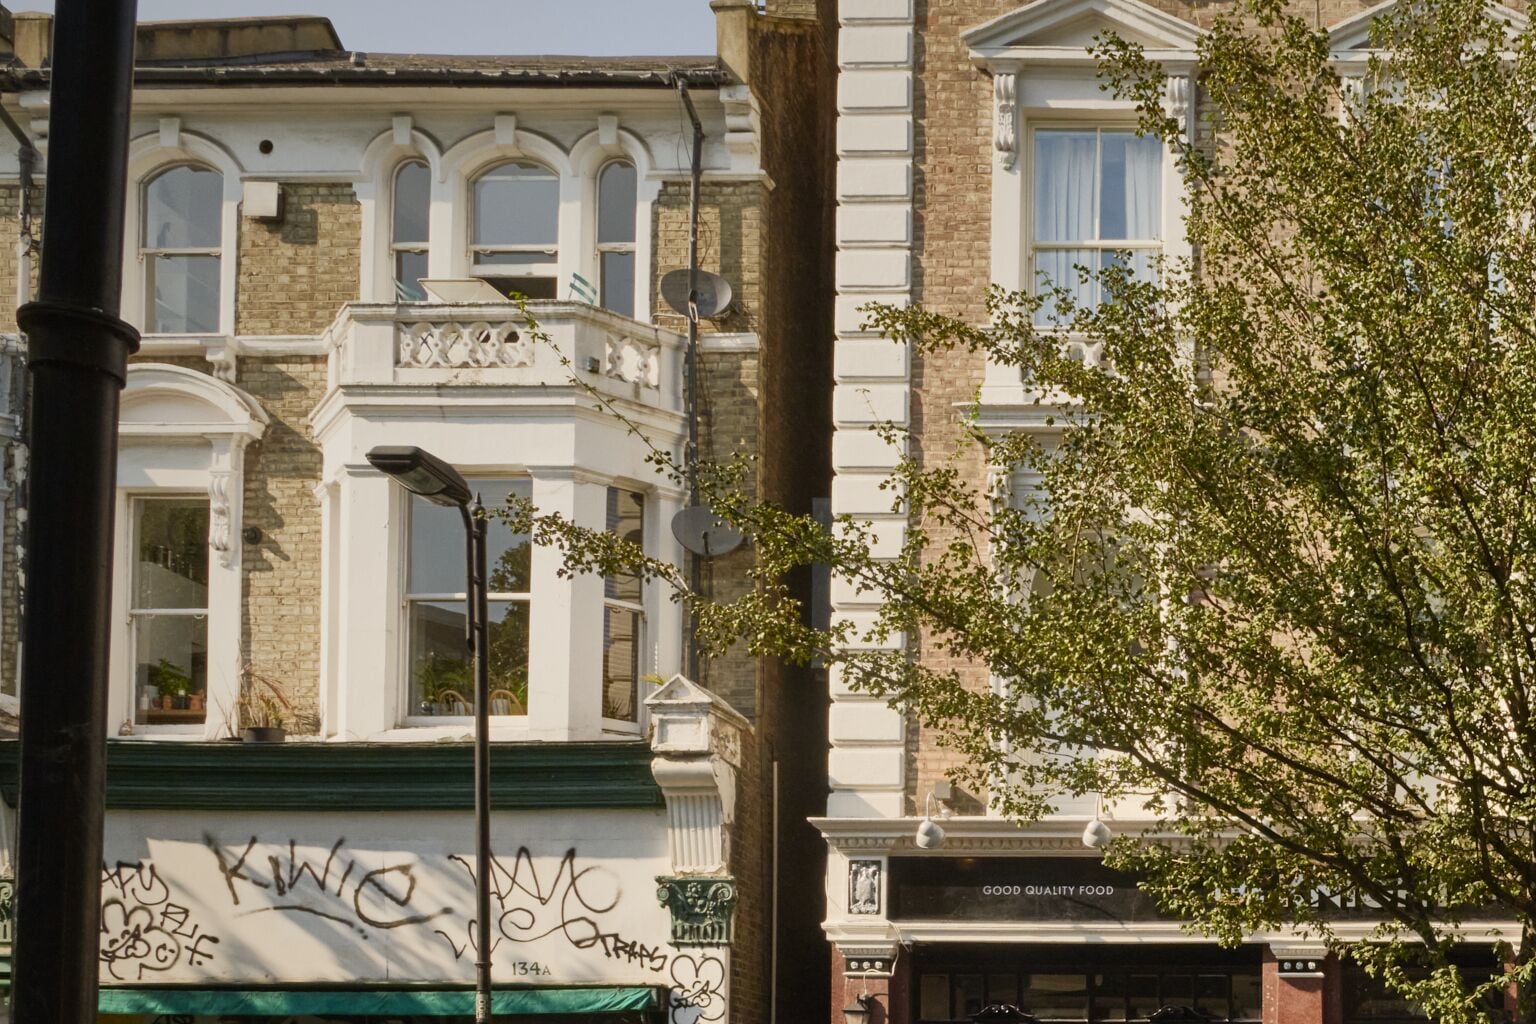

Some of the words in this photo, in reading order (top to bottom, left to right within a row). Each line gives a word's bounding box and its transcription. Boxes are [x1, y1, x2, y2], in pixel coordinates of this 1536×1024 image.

[982, 885, 1021, 896] GOOD
[1025, 885, 1076, 896] QUALITY
[1079, 885, 1114, 896] FOOD
